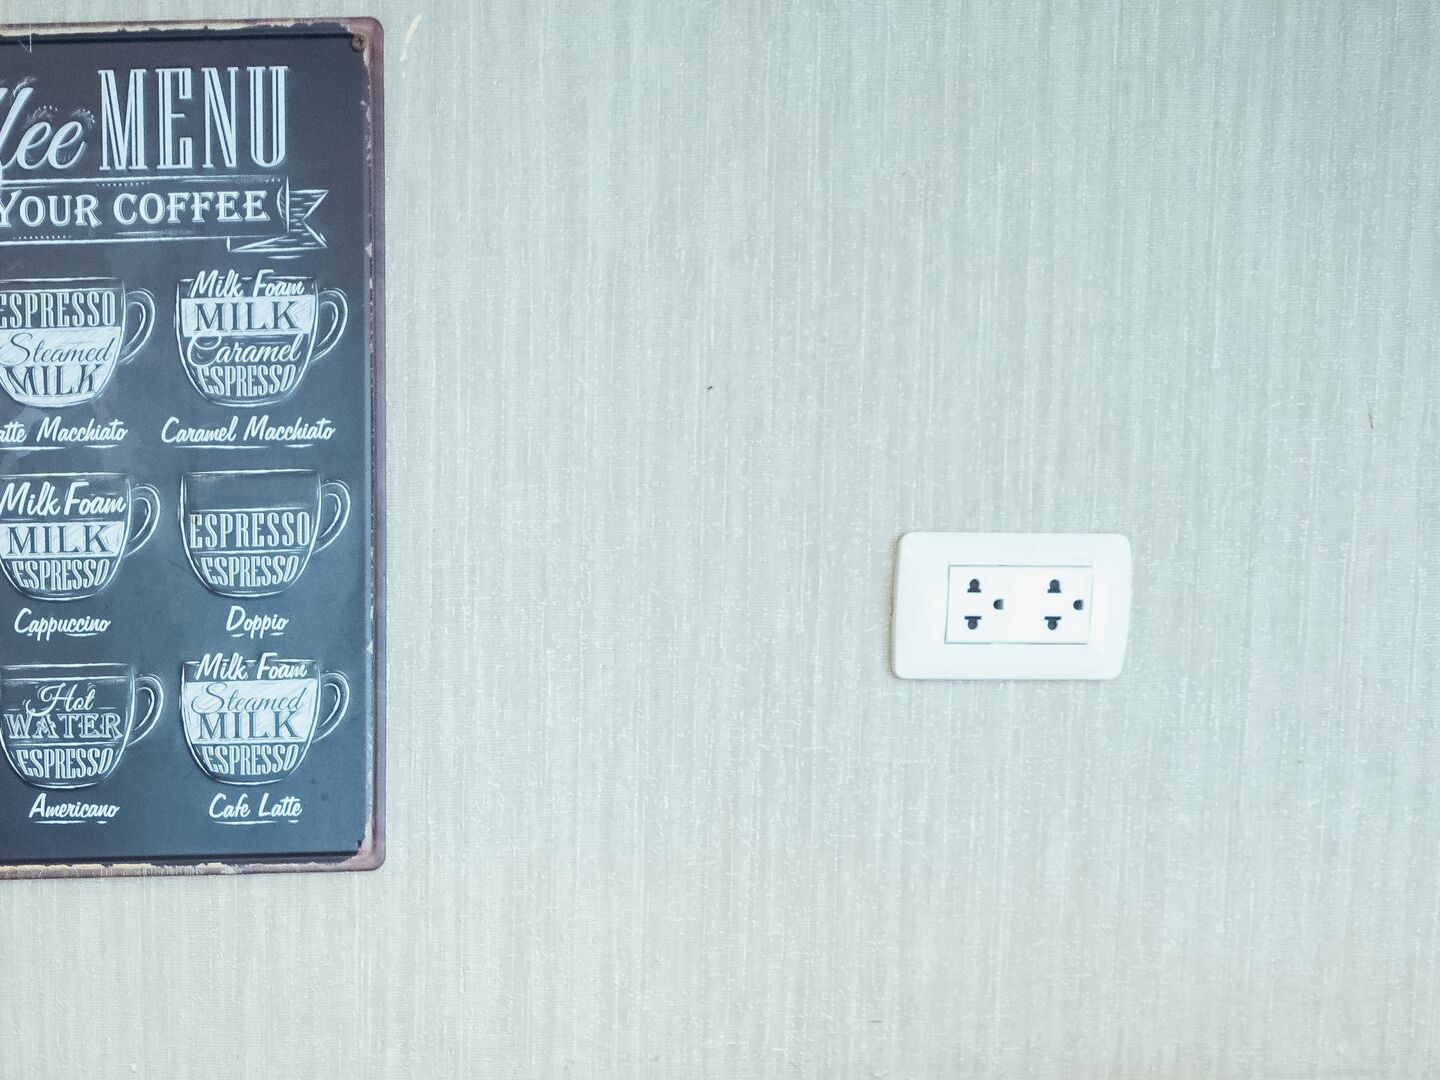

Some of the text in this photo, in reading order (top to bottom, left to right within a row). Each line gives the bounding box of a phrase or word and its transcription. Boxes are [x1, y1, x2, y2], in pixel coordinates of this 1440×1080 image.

[98, 66, 289, 171] MENU
[112, 188, 270, 224] COFFEE
[191, 269, 305, 298] Milk Foam
[194, 302, 299, 332] MILK
[188, 331, 302, 365] Caramel
[4, 364, 106, 397] MILK
[197, 364, 298, 396] ESPRESSO
[38, 418, 130, 442] Macchiato
[161, 416, 336, 443] Caramel Macchiato
[64, 481, 127, 516] Foam
[7, 524, 113, 555] MILK
[188, 510, 311, 548] ESPRESSO
[12, 558, 109, 591] ESPRESSO
[200, 554, 299, 586] ESPRESSO
[13, 608, 111, 640] Cappuccino
[225, 605, 290, 638] Doppio
[194, 652, 308, 681] Milk Foam
[24, 681, 96, 717] Hot
[190, 682, 303, 715] Steamed
[4, 712, 124, 743] WATER
[197, 712, 299, 740] MILK
[17, 746, 114, 779] ESPRESSO
[202, 744, 299, 776] ESPRESSO
[29, 793, 120, 819] Americano
[209, 793, 303, 819] Cafe Latte
